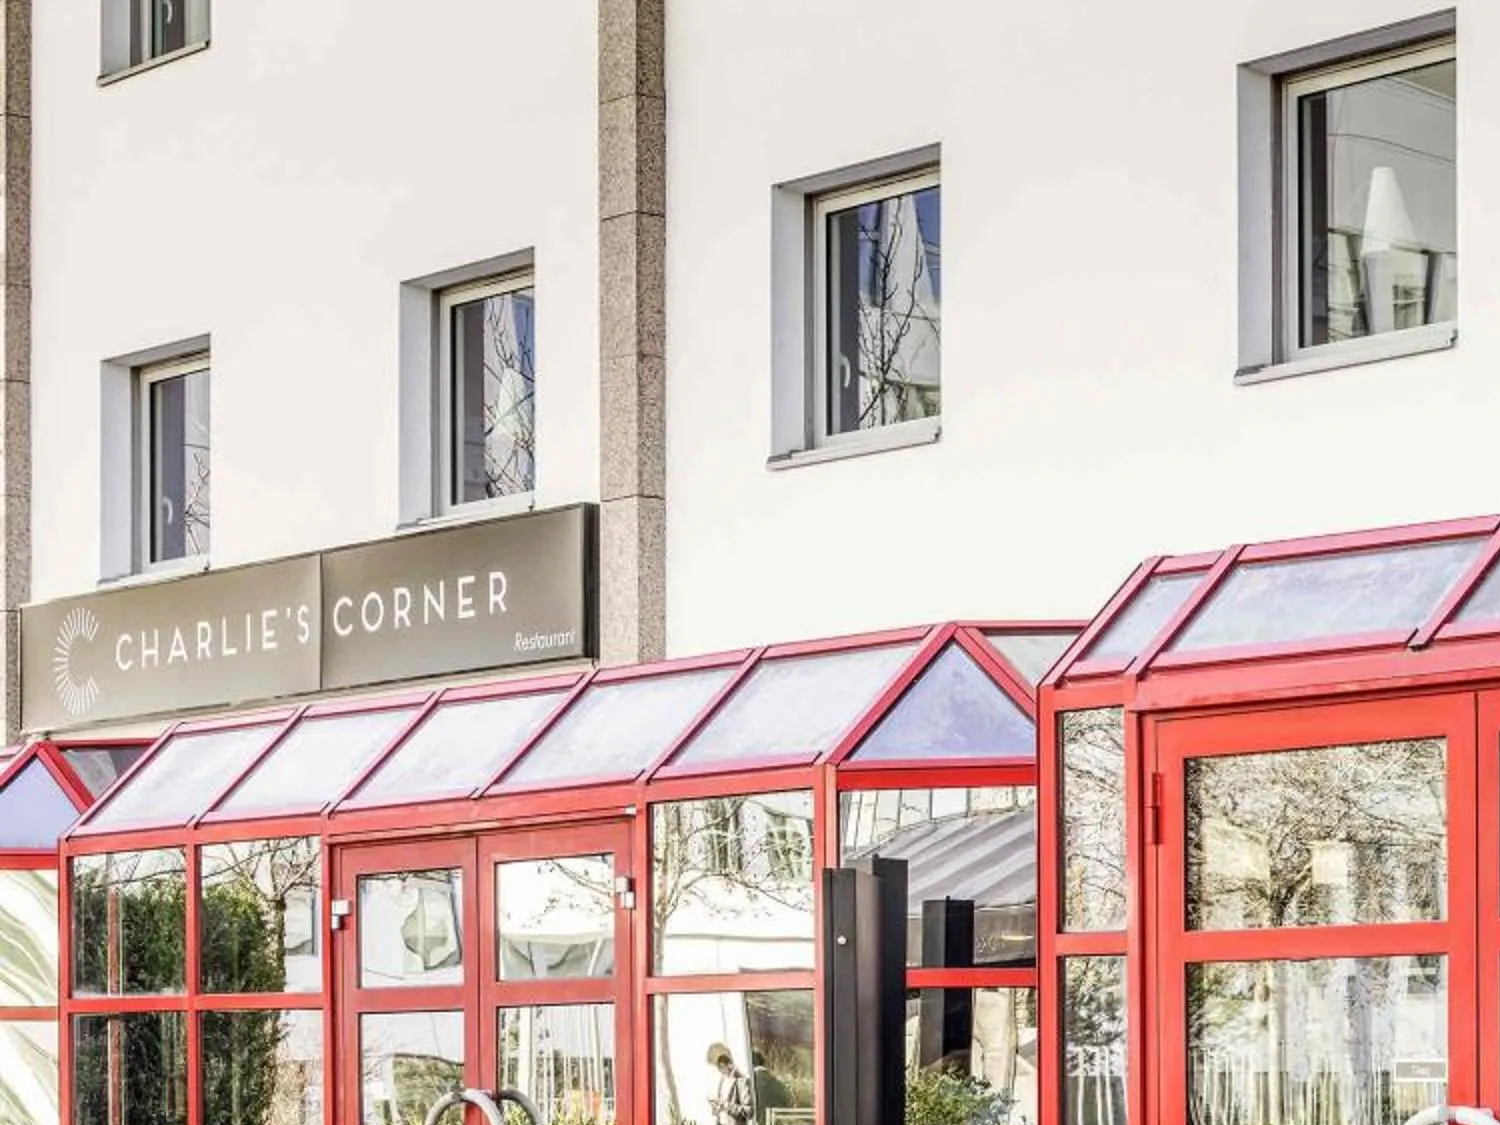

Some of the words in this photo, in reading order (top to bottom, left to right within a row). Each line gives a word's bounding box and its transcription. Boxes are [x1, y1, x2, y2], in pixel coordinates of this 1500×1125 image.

[115, 604, 311, 671] CHARLIE'S
[332, 571, 508, 637] CORNER
[513, 631, 577, 652] Restaurant
